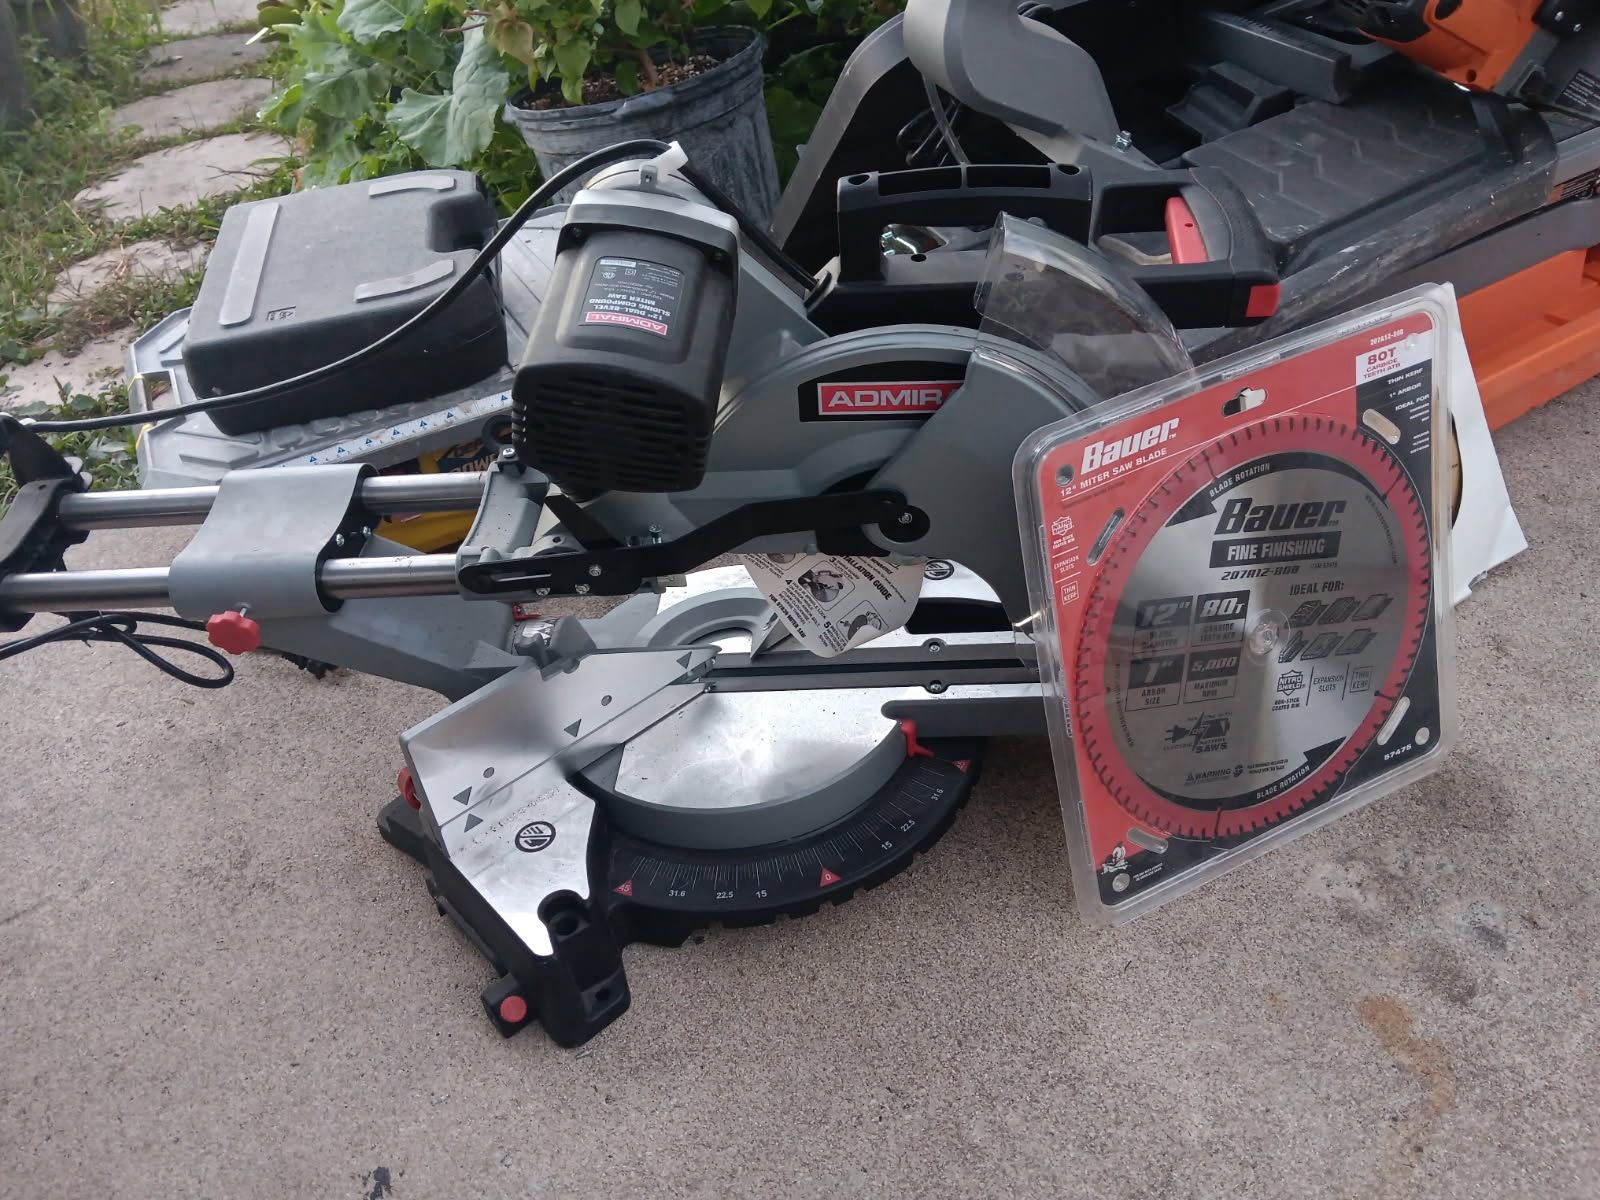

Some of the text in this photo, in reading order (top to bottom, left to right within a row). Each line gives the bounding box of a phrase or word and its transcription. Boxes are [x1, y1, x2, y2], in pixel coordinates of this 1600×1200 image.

[589, 298, 671, 316] SLIDING COMPOUND
[629, 296, 655, 305] MITER
[594, 304, 646, 316] DUAL-BEVEL
[592, 313, 663, 330] ADMIRAL
[1367, 346, 1397, 365] 80T
[1366, 358, 1398, 373] CARBIDE
[1363, 367, 1386, 379] TEETH
[1387, 368, 1424, 385] THIN KERF
[1398, 382, 1422, 395] ARBOR
[1395, 400, 1415, 411] IDEAL
[1416, 393, 1430, 404] FOR
[1081, 418, 1180, 475] Bauer
[1080, 470, 1110, 490] MITER
[1112, 461, 1133, 476] SAW
[1136, 447, 1168, 465] BLADE
[1209, 462, 1271, 497] BLADE ROTATION
[1214, 497, 1347, 535] Bauer
[1227, 538, 1326, 561] FINE FINISHING
[873, 580, 892, 600] GUIDE
[1063, 584, 1076, 594] THIN
[1290, 580, 1345, 596] IDEAL FOR:
[1200, 597, 1245, 618] 80T
[786, 614, 799, 628] MITER
[796, 627, 806, 638] SAW
[1192, 656, 1238, 673] 5,000
[1278, 682, 1301, 690] SHIELD
[1279, 676, 1302, 684] NITRO
[1313, 675, 1344, 685] EXPANSION
[1141, 687, 1166, 697] ARBOR
[1318, 684, 1336, 692] SLOTS
[1144, 696, 1161, 705] SIZE
[1195, 742, 1228, 754] SAWS
[1384, 743, 1412, 760] 57475
[1195, 768, 1232, 781] WARNING
[1256, 785, 1278, 799] BLADE
[1279, 765, 1310, 789] ROTATION
[931, 788, 944, 800] 31.6
[900, 819, 916, 832] 22.5
[881, 841, 893, 850] 15
[825, 873, 832, 881] 0
[716, 891, 734, 899] 22.5
[755, 890, 768, 899] 15
